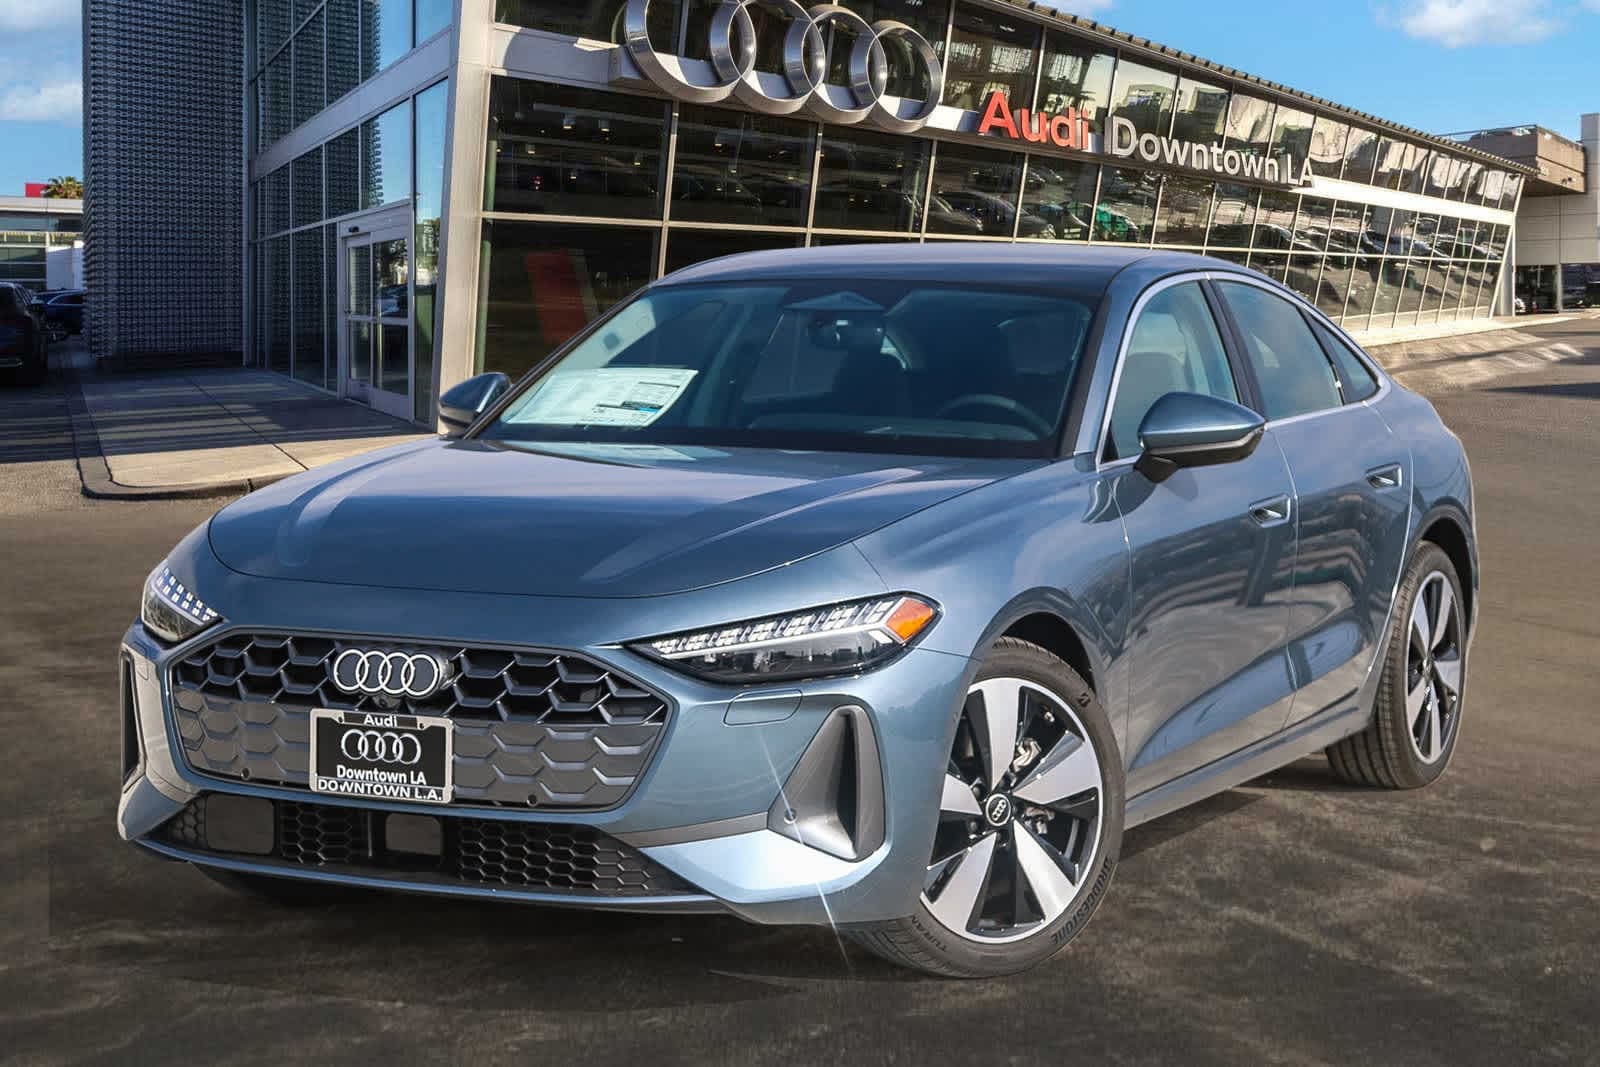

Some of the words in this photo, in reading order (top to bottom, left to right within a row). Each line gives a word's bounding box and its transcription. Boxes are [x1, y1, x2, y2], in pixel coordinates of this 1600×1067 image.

[978, 91, 1090, 149] Audi
[1104, 115, 1279, 182] Downtown
[1280, 153, 1315, 188] LA
[364, 714, 397, 727] Audi
[336, 765, 407, 783] Downtown
[410, 770, 427, 785] LA
[318, 779, 411, 798] DOWNTOWN
[414, 787, 442, 801] L.A.
